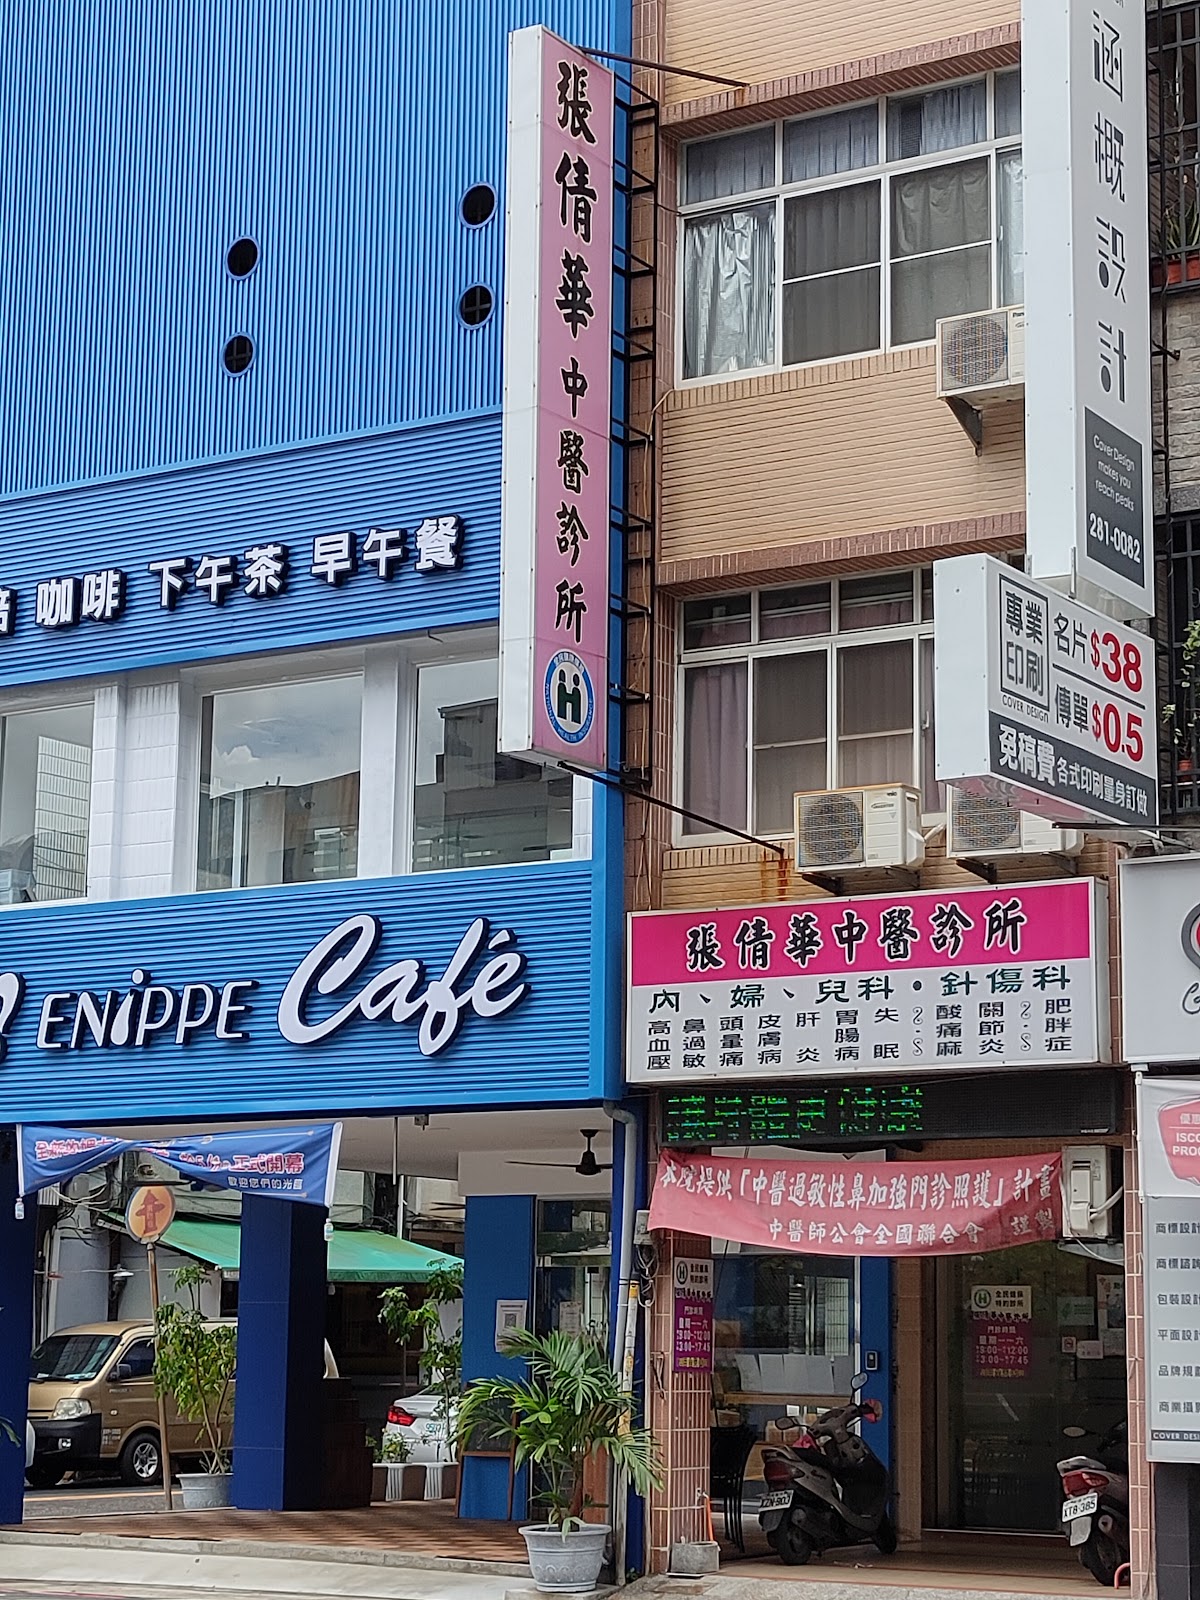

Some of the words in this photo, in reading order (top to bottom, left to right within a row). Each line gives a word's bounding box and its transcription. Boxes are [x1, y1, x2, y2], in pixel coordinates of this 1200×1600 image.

[554, 60, 599, 644] 張倩華中醫診所
[1093, 434, 1114, 457] Cover
[1113, 447, 1135, 472] Design
[1097, 460, 1119, 482] makes
[1118, 473, 1132, 489] you
[1095, 479, 1115, 500] reach
[1115, 492, 1134, 512] peaks
[1089, 511, 1141, 564] 281-0082
[35, 570, 121, 628] 咖啡
[148, 544, 286, 608] 下午茶
[310, 515, 462, 585] 早午餐
[1005, 590, 1043, 646] 專業
[1006, 640, 1043, 697] 印刷
[1053, 611, 1088, 664] 名片
[1090, 628, 1143, 694] $38
[1002, 694, 1024, 713] COVER
[1054, 683, 1089, 734] 傳單
[1091, 700, 1144, 762] $0.5
[998, 723, 1056, 788] 免稿費
[1056, 757, 1148, 817] 各式印刷量身訂做
[686, 898, 1027, 972] 張倩華中醫診所
[277, 914, 532, 1057] Café
[646, 1019, 672, 1071] 高血壓
[682, 1018, 706, 1069] 鼻過敏
[757, 1013, 782, 1065] 皮膚病
[795, 1011, 821, 1064] 肝炎
[834, 1008, 860, 1061] 胃腸病
[873, 1006, 900, 1060] 失眠
[935, 1003, 962, 1057] 酸痛麻
[978, 1000, 1005, 1056] 關節炎
[1044, 998, 1072, 1053] 肥胖症
[768, 1217, 985, 1246] 中醫師公會全國聯合會
[1153, 1431, 1180, 1441] COVER
